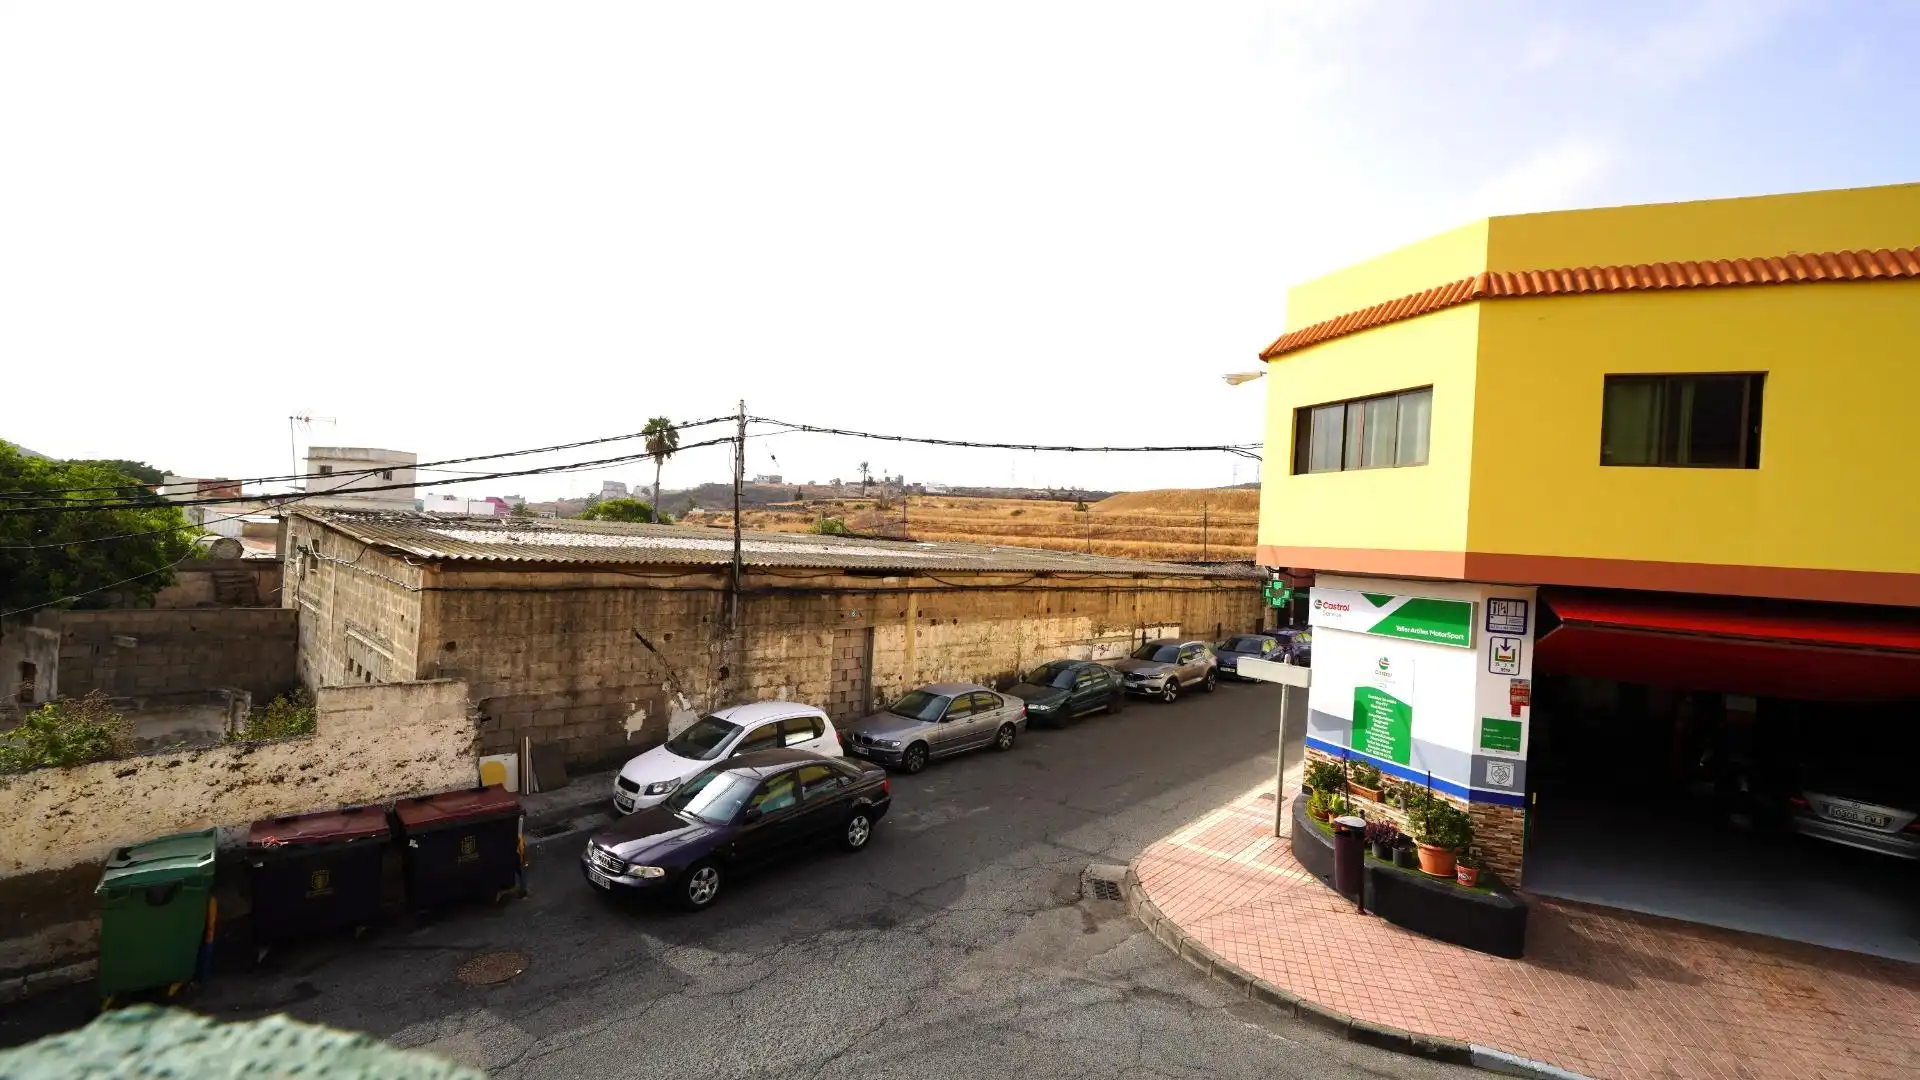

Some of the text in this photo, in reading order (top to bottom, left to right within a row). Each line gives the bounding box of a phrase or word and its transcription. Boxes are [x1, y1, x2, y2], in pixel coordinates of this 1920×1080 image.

[1322, 601, 1350, 611] Castrol
[1396, 625, 1410, 633] Taller
[1429, 629, 1465, 640] MotorSport
